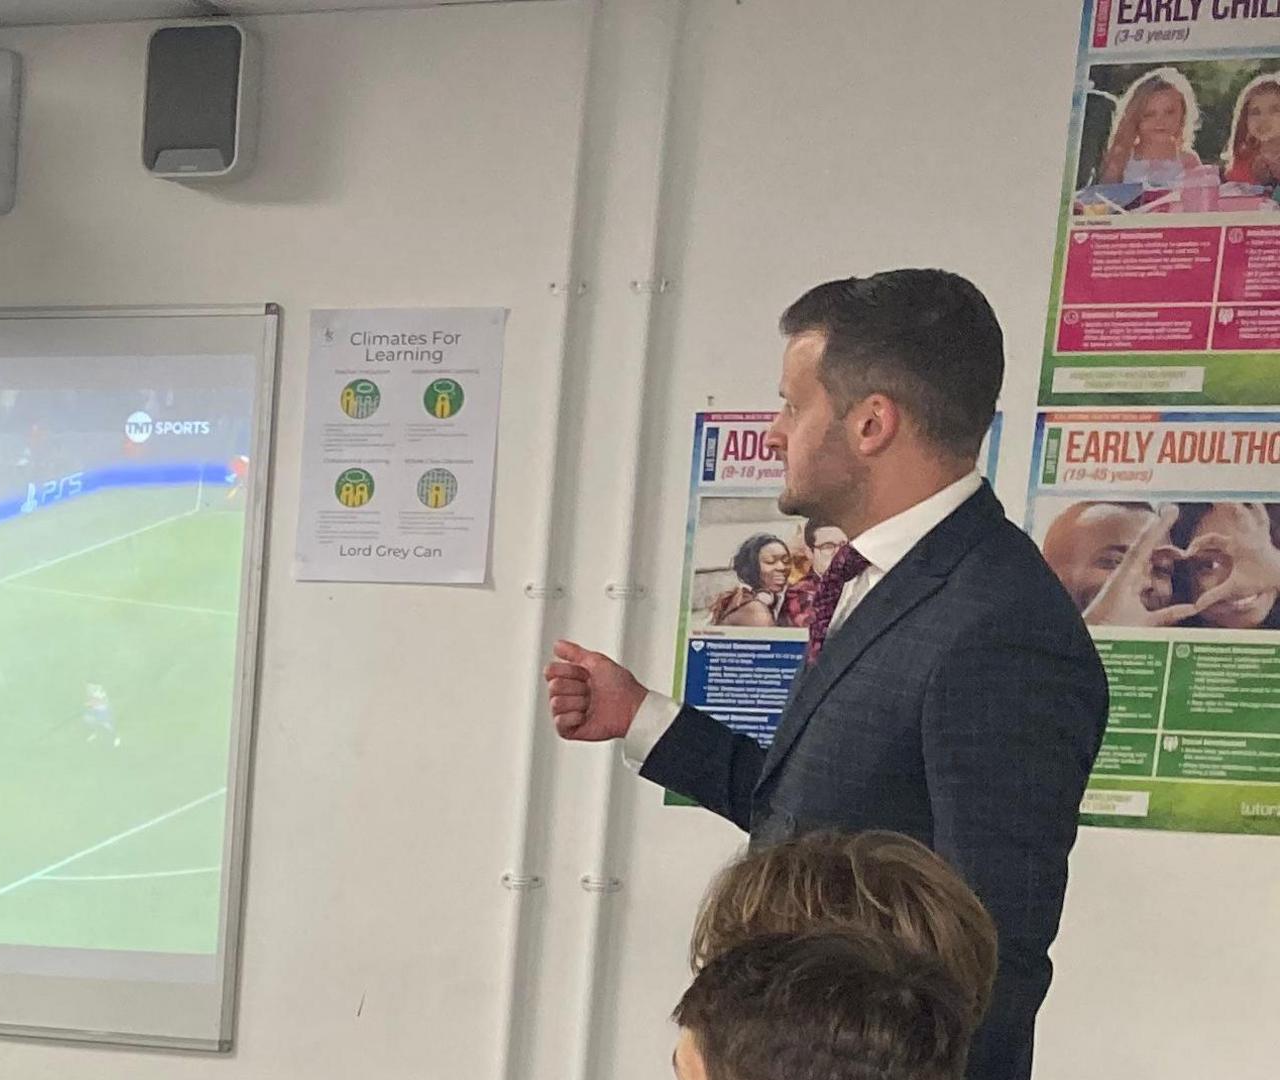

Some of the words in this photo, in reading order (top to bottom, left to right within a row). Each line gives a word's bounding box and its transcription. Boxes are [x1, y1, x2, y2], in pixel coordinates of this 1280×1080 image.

[1117, 0, 1199, 24] EARLY
[1115, 28, 1144, 45] (3-8
[1146, 27, 1190, 44] years)
[350, 331, 428, 346] Climates
[432, 331, 462, 345] For
[365, 348, 444, 365] Learning
[154, 421, 210, 435] SPORTS
[1065, 430, 1155, 464] EARLY
[1110, 468, 1154, 484] years)
[41, 471, 84, 503] PS5
[339, 545, 372, 557] Lord
[375, 545, 410, 560] Grey
[413, 545, 443, 558] Can
